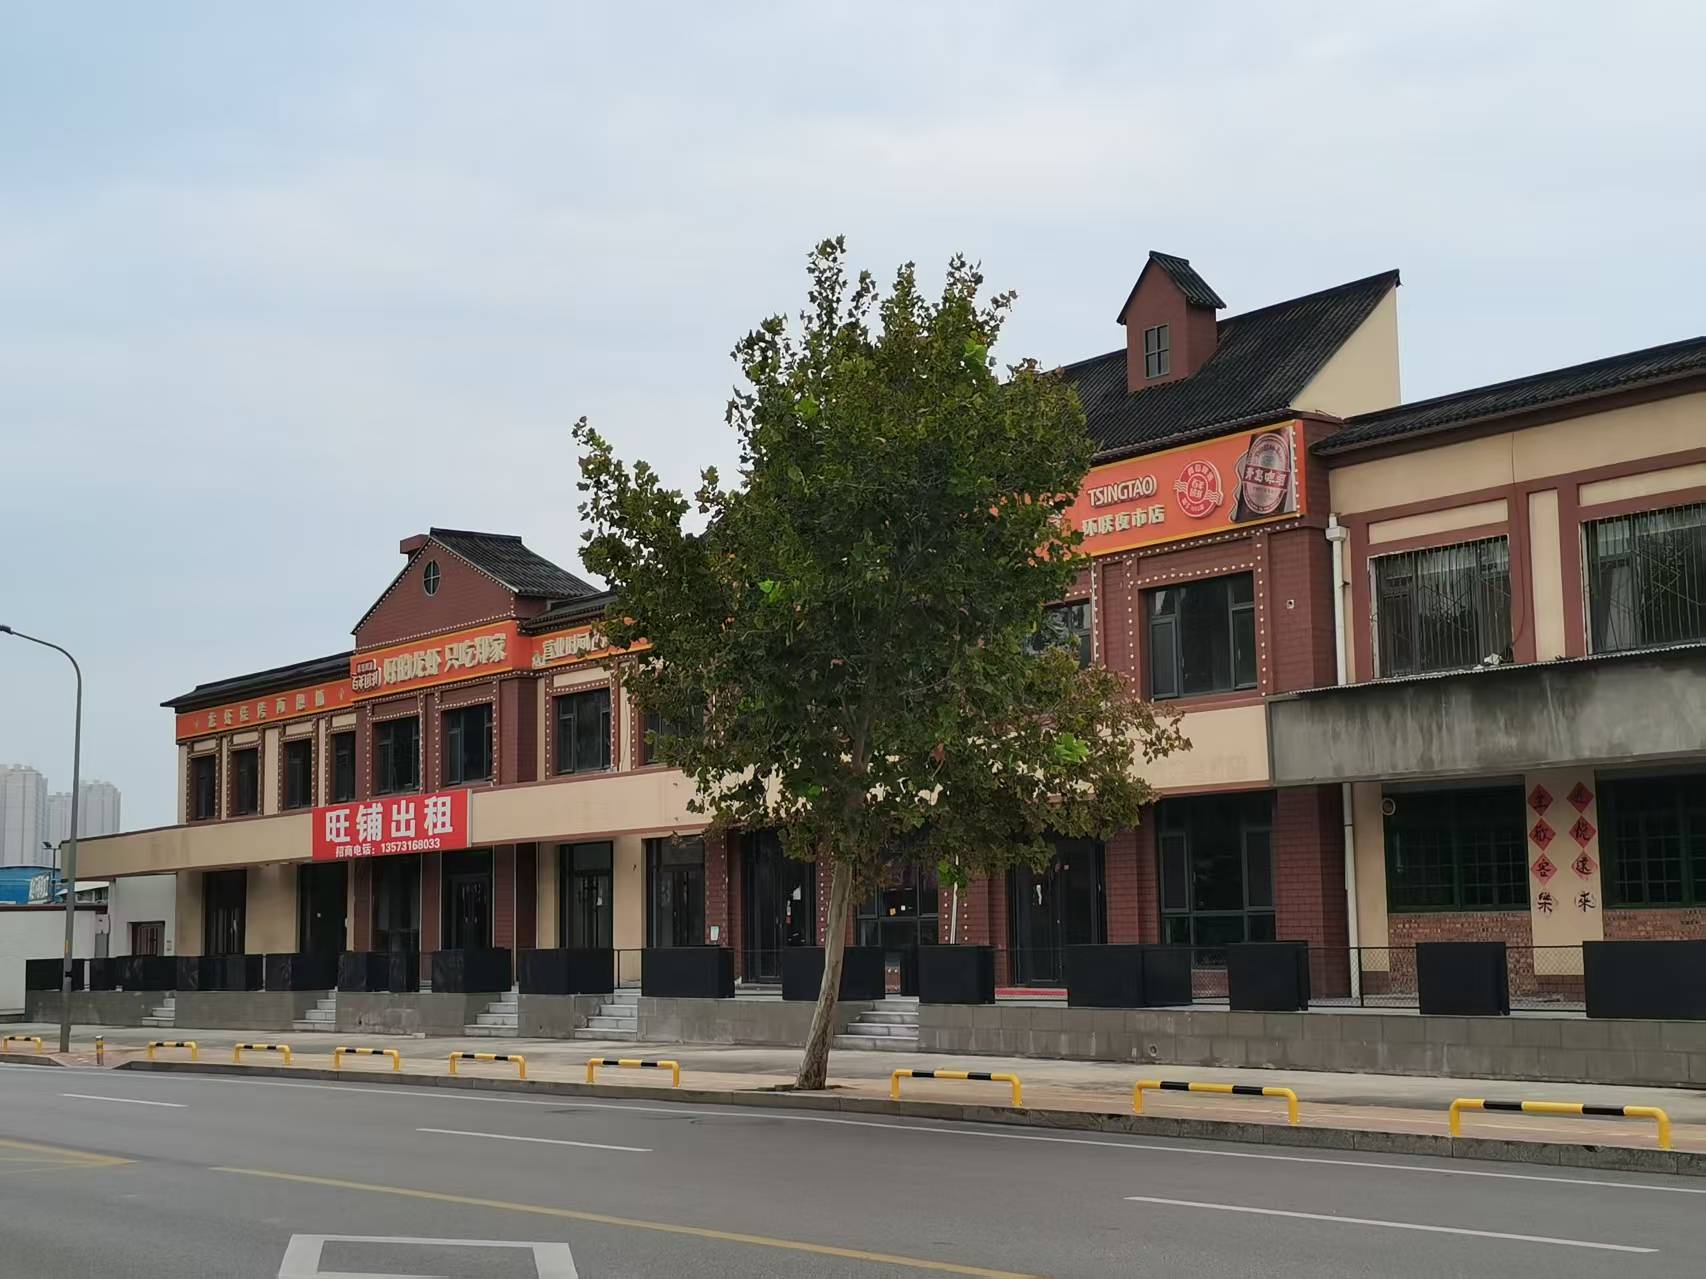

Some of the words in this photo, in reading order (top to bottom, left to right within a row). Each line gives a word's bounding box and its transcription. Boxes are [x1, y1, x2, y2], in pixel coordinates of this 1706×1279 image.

[1088, 475, 1155, 506] TSINGTAO
[325, 795, 453, 843] 旺铺出租
[381, 838, 440, 853] 13573168033
